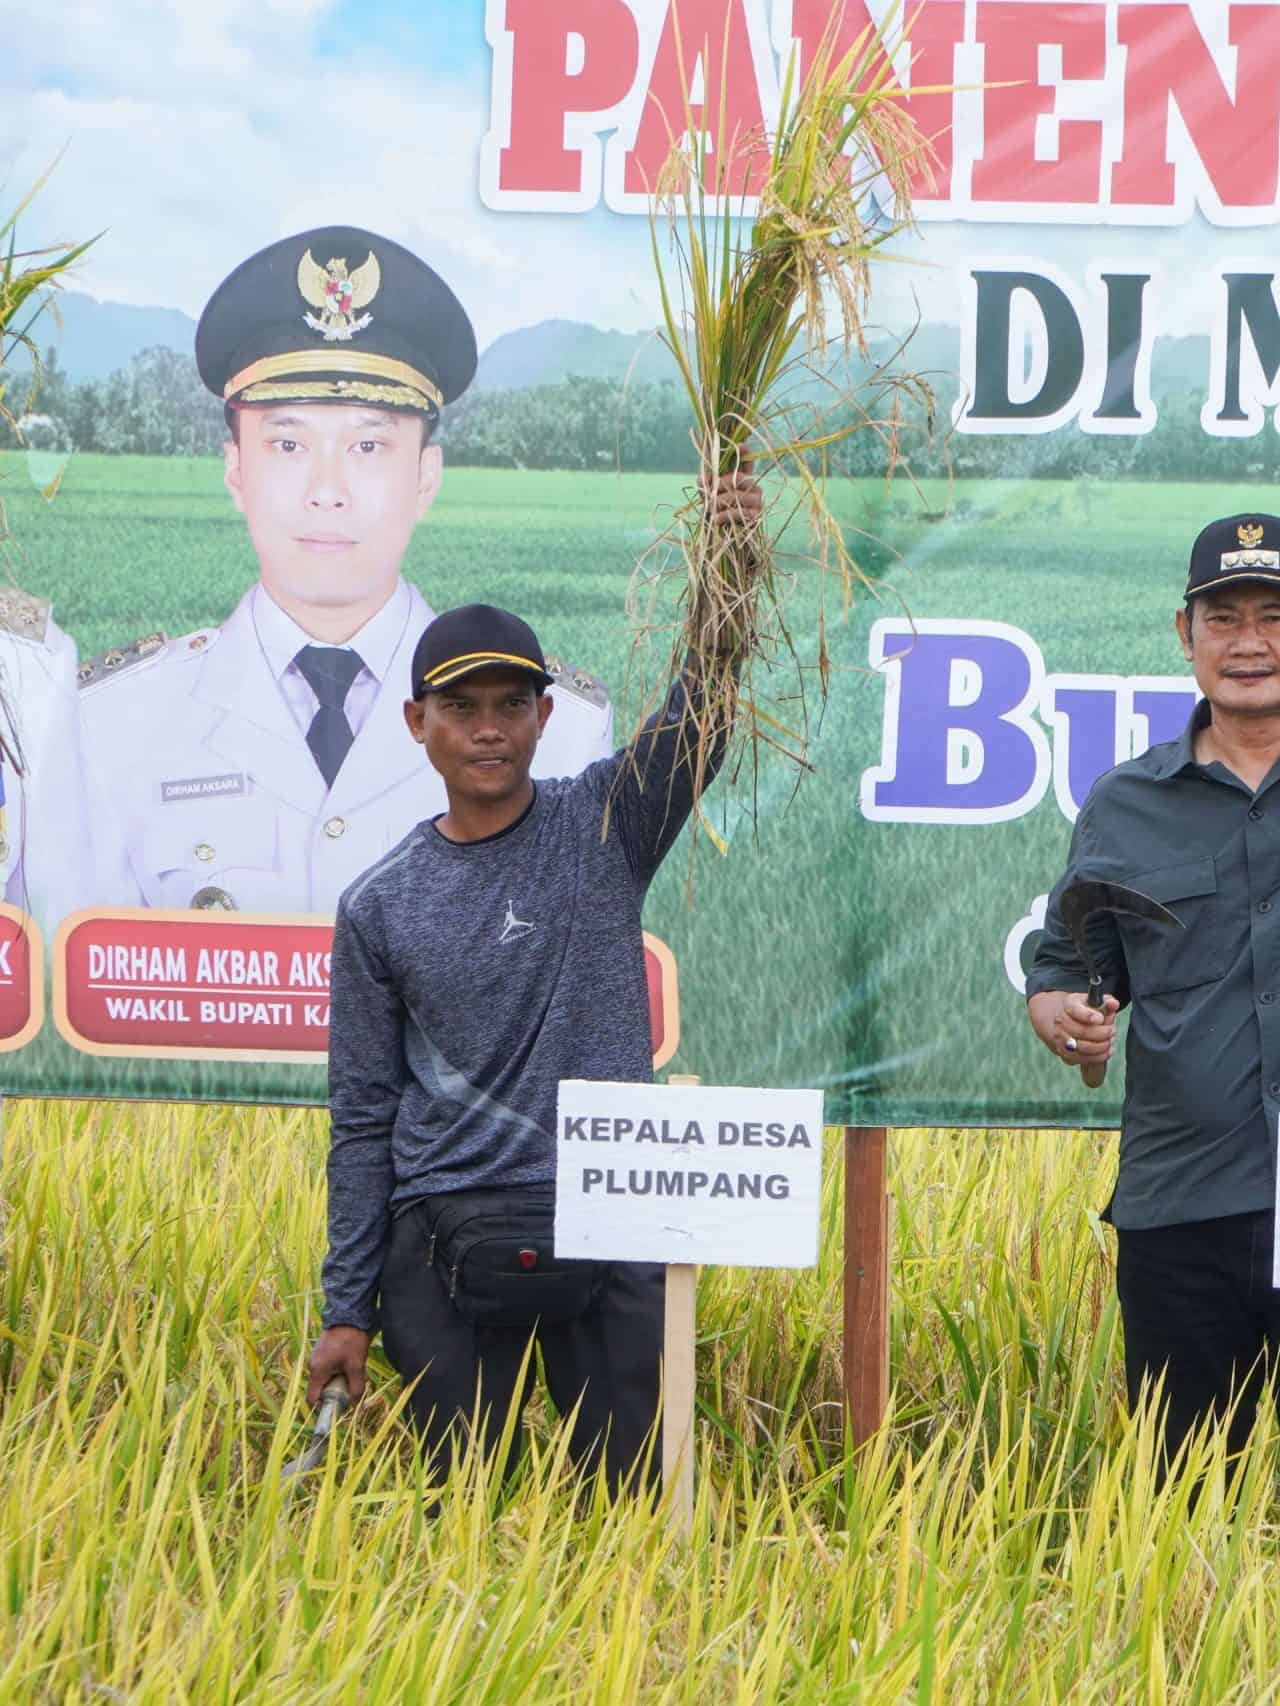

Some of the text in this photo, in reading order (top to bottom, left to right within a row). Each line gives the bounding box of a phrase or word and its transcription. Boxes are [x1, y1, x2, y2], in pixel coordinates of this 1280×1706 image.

[965, 271, 1152, 420] DI
[88, 944, 187, 983] DIRHAM
[196, 949, 281, 986] AKBAR
[105, 997, 191, 1023] WAKIL
[200, 1001, 292, 1026] BUPATI
[563, 1116, 812, 1149] KEPALA DESA
[582, 1168, 791, 1200] PLUMPANG
